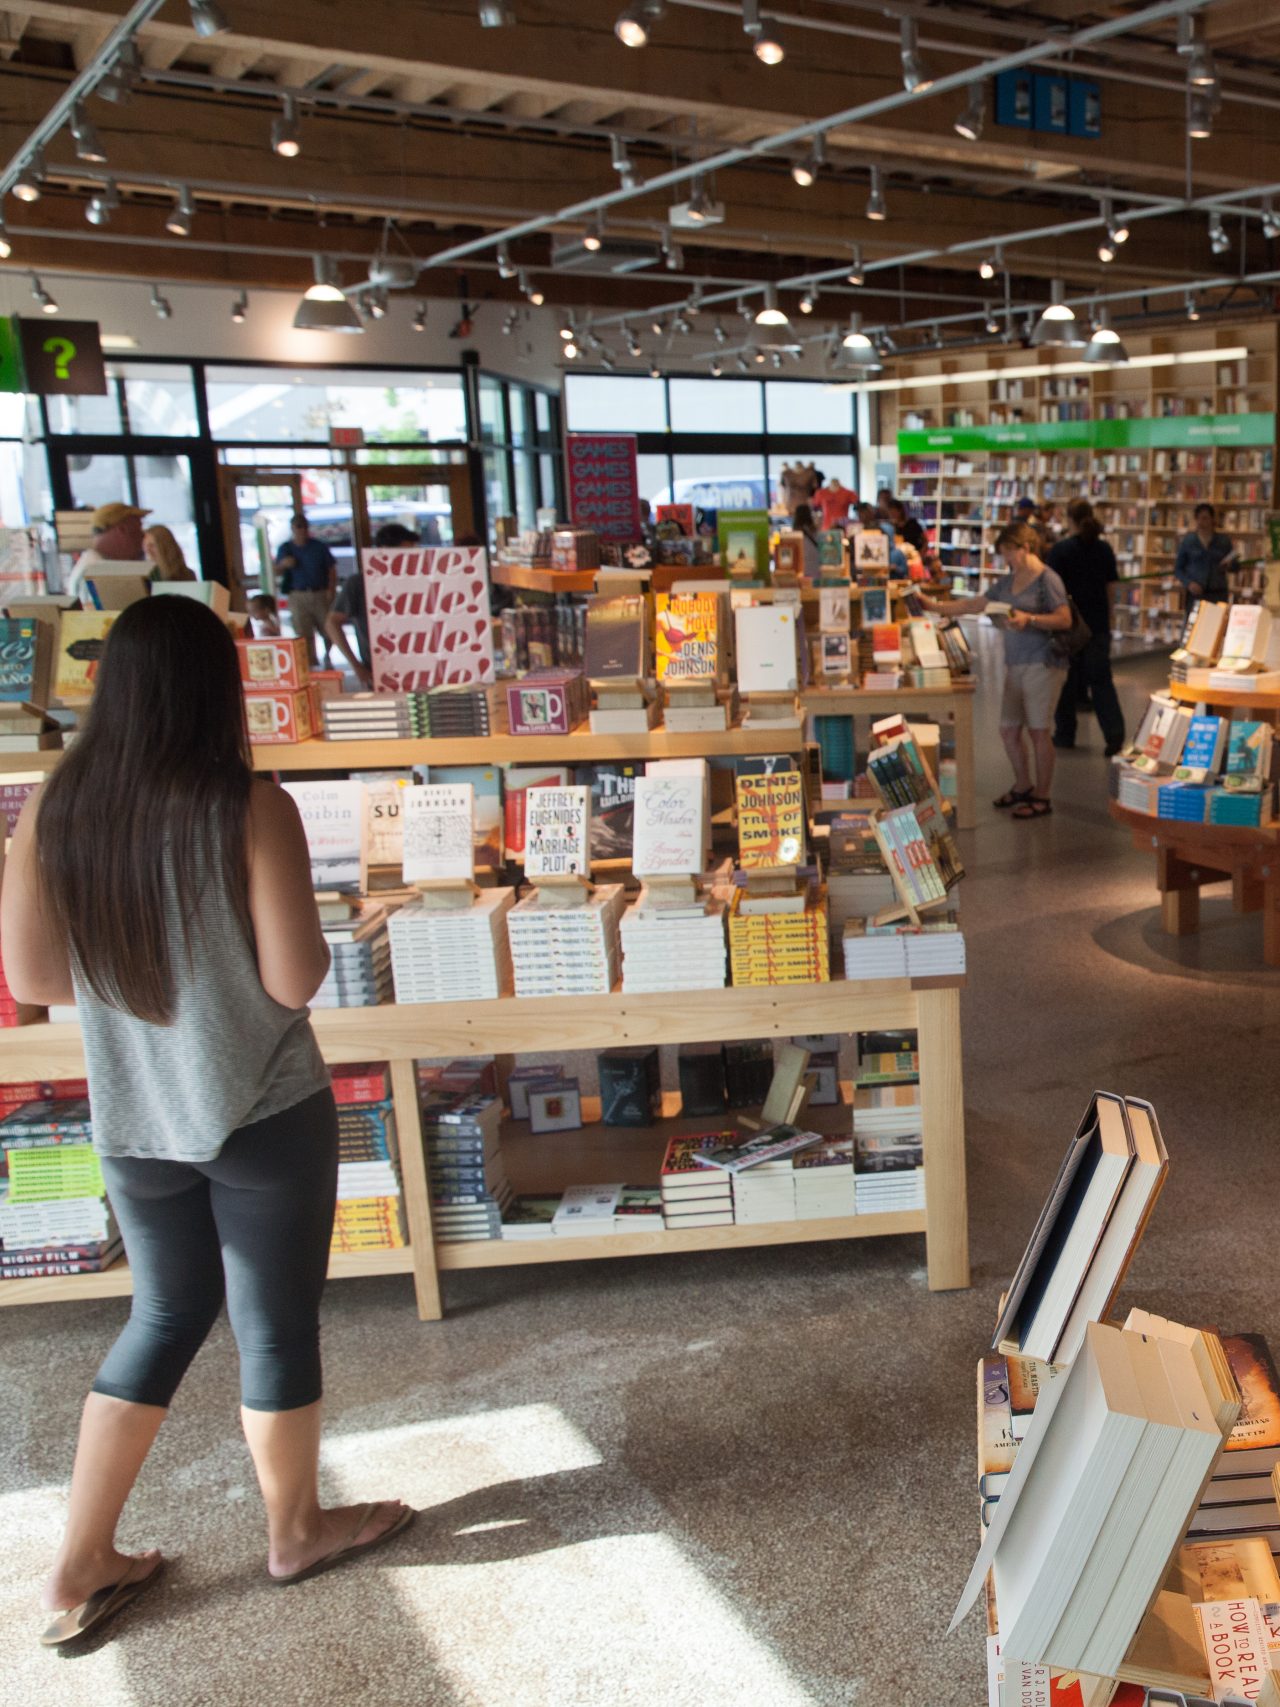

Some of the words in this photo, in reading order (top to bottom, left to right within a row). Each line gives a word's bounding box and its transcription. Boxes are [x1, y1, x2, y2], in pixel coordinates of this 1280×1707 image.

[572, 442, 629, 459] GAMES
[573, 462, 631, 478] GAMES
[575, 482, 631, 498] GAMES
[576, 502, 632, 517] GAMES
[366, 550, 481, 576] sale!
[370, 580, 483, 616] sale!
[670, 599, 716, 616] NOBODY
[686, 617, 715, 632] MOVE
[374, 619, 487, 655] sale!
[682, 642, 716, 656] DENIS
[664, 662, 716, 676] JOHNSON
[741, 776, 799, 788] DENIS
[536, 792, 575, 808] JEFFREY
[741, 792, 800, 808] JOHNSON
[530, 809, 581, 826] EUGENIDES
[743, 814, 779, 824] TREE
[783, 812, 799, 822] OF
[743, 827, 800, 840] SMOKE
[529, 838, 579, 854] MARRIAGE
[542, 856, 566, 872] PLOT
[2, 1252, 43, 1264] NIGHT
[46, 1251, 79, 1261] FILM
[3, 1266, 43, 1278] NIGHT
[48, 1264, 80, 1274] FILM
[1228, 1602, 1250, 1634] HOW
[1239, 1638, 1250, 1649] TO
[1212, 1633, 1235, 1680] BOOK
